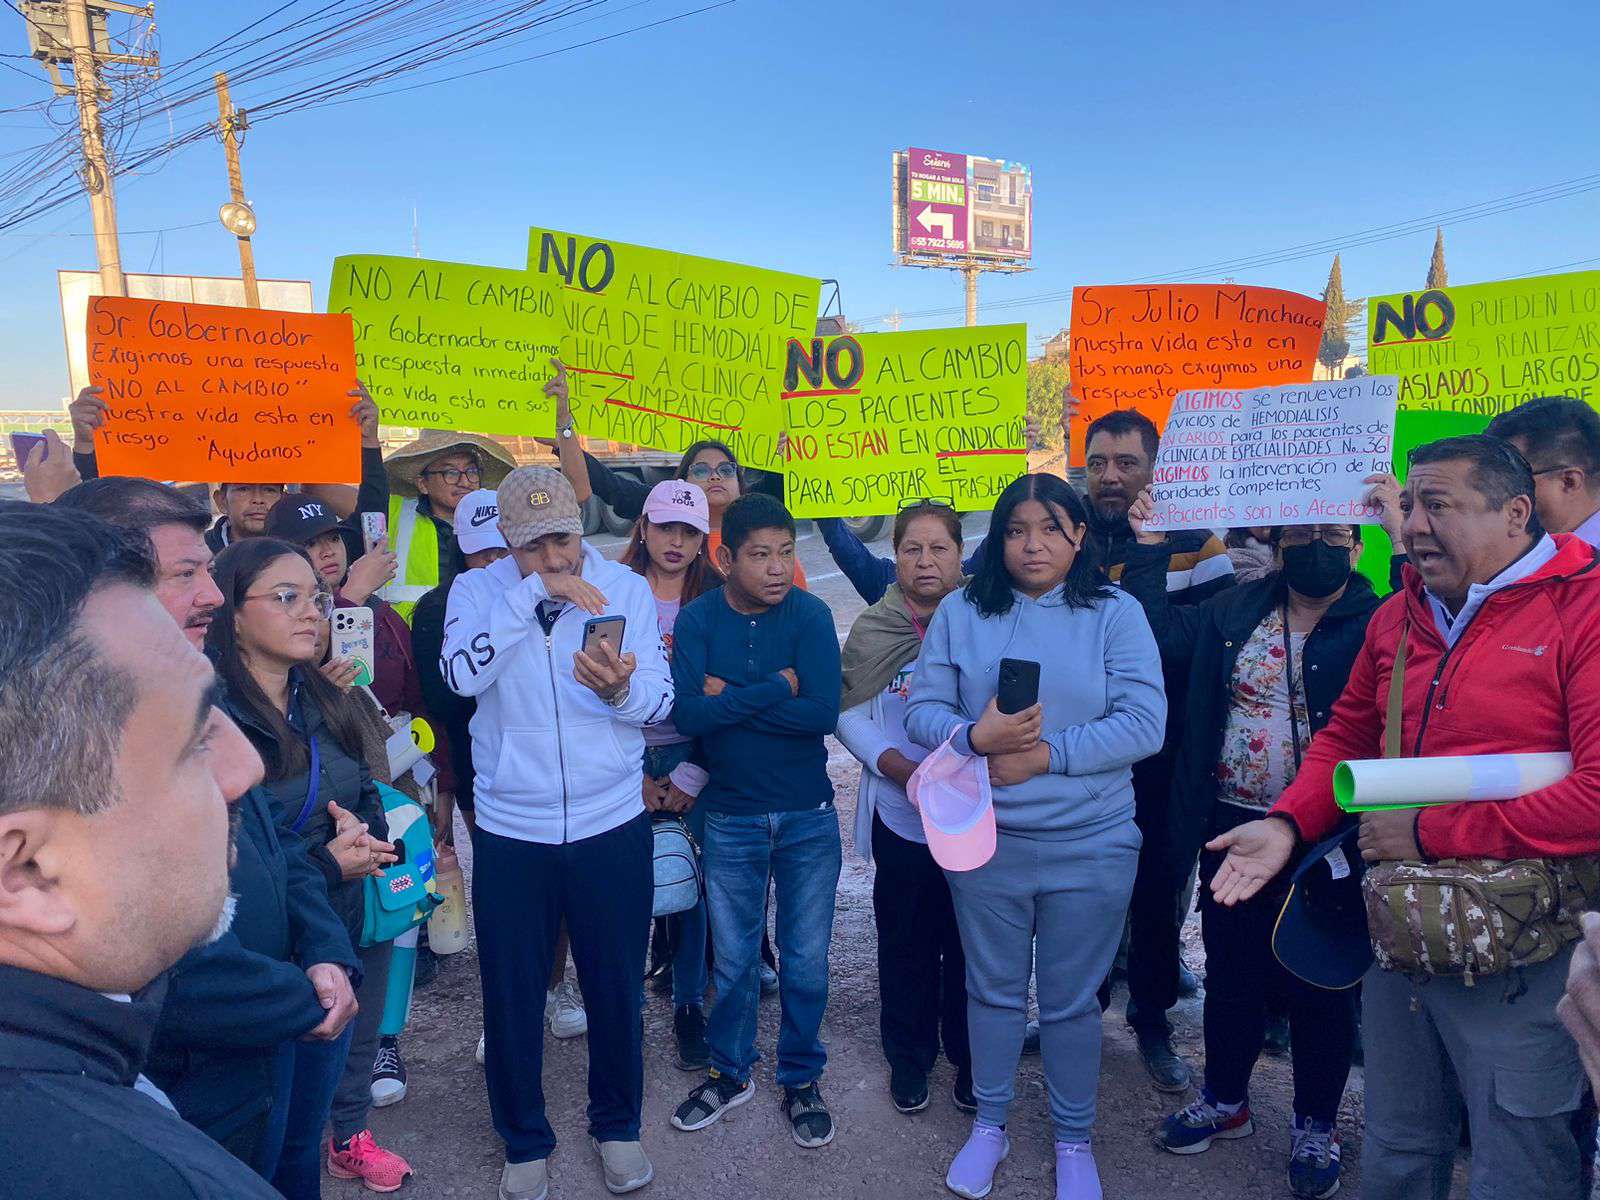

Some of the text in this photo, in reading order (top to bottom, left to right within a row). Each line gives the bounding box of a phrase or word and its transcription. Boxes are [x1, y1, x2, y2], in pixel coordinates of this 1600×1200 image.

[911, 181, 964, 203] 5 MIN.
[349, 264, 555, 318] NO AL CAMBIO
[539, 232, 809, 330] NO AL CAMBIO DE
[1132, 288, 1200, 323] Julio
[1373, 287, 1600, 343] NO PUEDEN LO
[93, 297, 316, 347] Sr. Gobernador
[623, 311, 660, 349] DE
[390, 313, 498, 349] Gobernador
[504, 339, 560, 363] exigimos
[1073, 329, 1297, 354] nuestra vida esta en
[1372, 322, 1600, 374] PACIENTES REALIZAR
[92, 342, 193, 375] Exigimos
[207, 354, 245, 369] una
[254, 353, 340, 374] respuesta
[374, 353, 461, 379] respuesta
[652, 357, 673, 385] A
[782, 335, 1022, 392] NO AL CAMBIO
[1074, 355, 1303, 384] tus manos exigimos una
[156, 379, 185, 394] AL
[1397, 353, 1600, 401] ASLADOS LARGOS
[404, 385, 438, 404] vida
[449, 389, 487, 410] esta
[497, 399, 518, 411] en
[526, 399, 550, 413] sus
[788, 386, 1000, 429] LOS PACIENTES
[1082, 379, 1179, 408] respuesta
[1252, 395, 1272, 408] se
[1280, 385, 1362, 406] renueven
[1372, 382, 1393, 397] los
[196, 406, 239, 424] vida
[254, 405, 298, 424] esta
[310, 410, 335, 426] en
[381, 407, 454, 426] manos
[589, 403, 667, 448] MAYOR
[1222, 414, 1241, 428] de
[1251, 407, 1340, 427] HEMODIALISIS
[103, 430, 169, 451] riesgo
[786, 433, 818, 462] NO
[827, 427, 889, 461] ESTAN
[900, 427, 930, 454] EN
[1178, 431, 1225, 445] CARLOS
[1230, 429, 1263, 446] para
[1271, 428, 1288, 441] los
[1294, 423, 1363, 443] pacientes
[1367, 420, 1389, 434] de
[1212, 447, 1227, 461] DE
[1232, 440, 1332, 461] ESPECIALIDADES
[1363, 436, 1387, 454] 36
[1219, 465, 1235, 480] la
[1239, 458, 1337, 479] intervención
[1346, 458, 1363, 473] de
[1371, 457, 1391, 474] las
[789, 470, 836, 510] PARA
[842, 467, 934, 506] SOPORTAR
[938, 456, 967, 475] EL
[298, 503, 324, 520] NY
[475, 505, 498, 518] NIKE
[671, 497, 695, 507] TOUS
[1168, 498, 1236, 523] Pacientes
[1243, 503, 1271, 520] son
[1280, 500, 1299, 518] los
